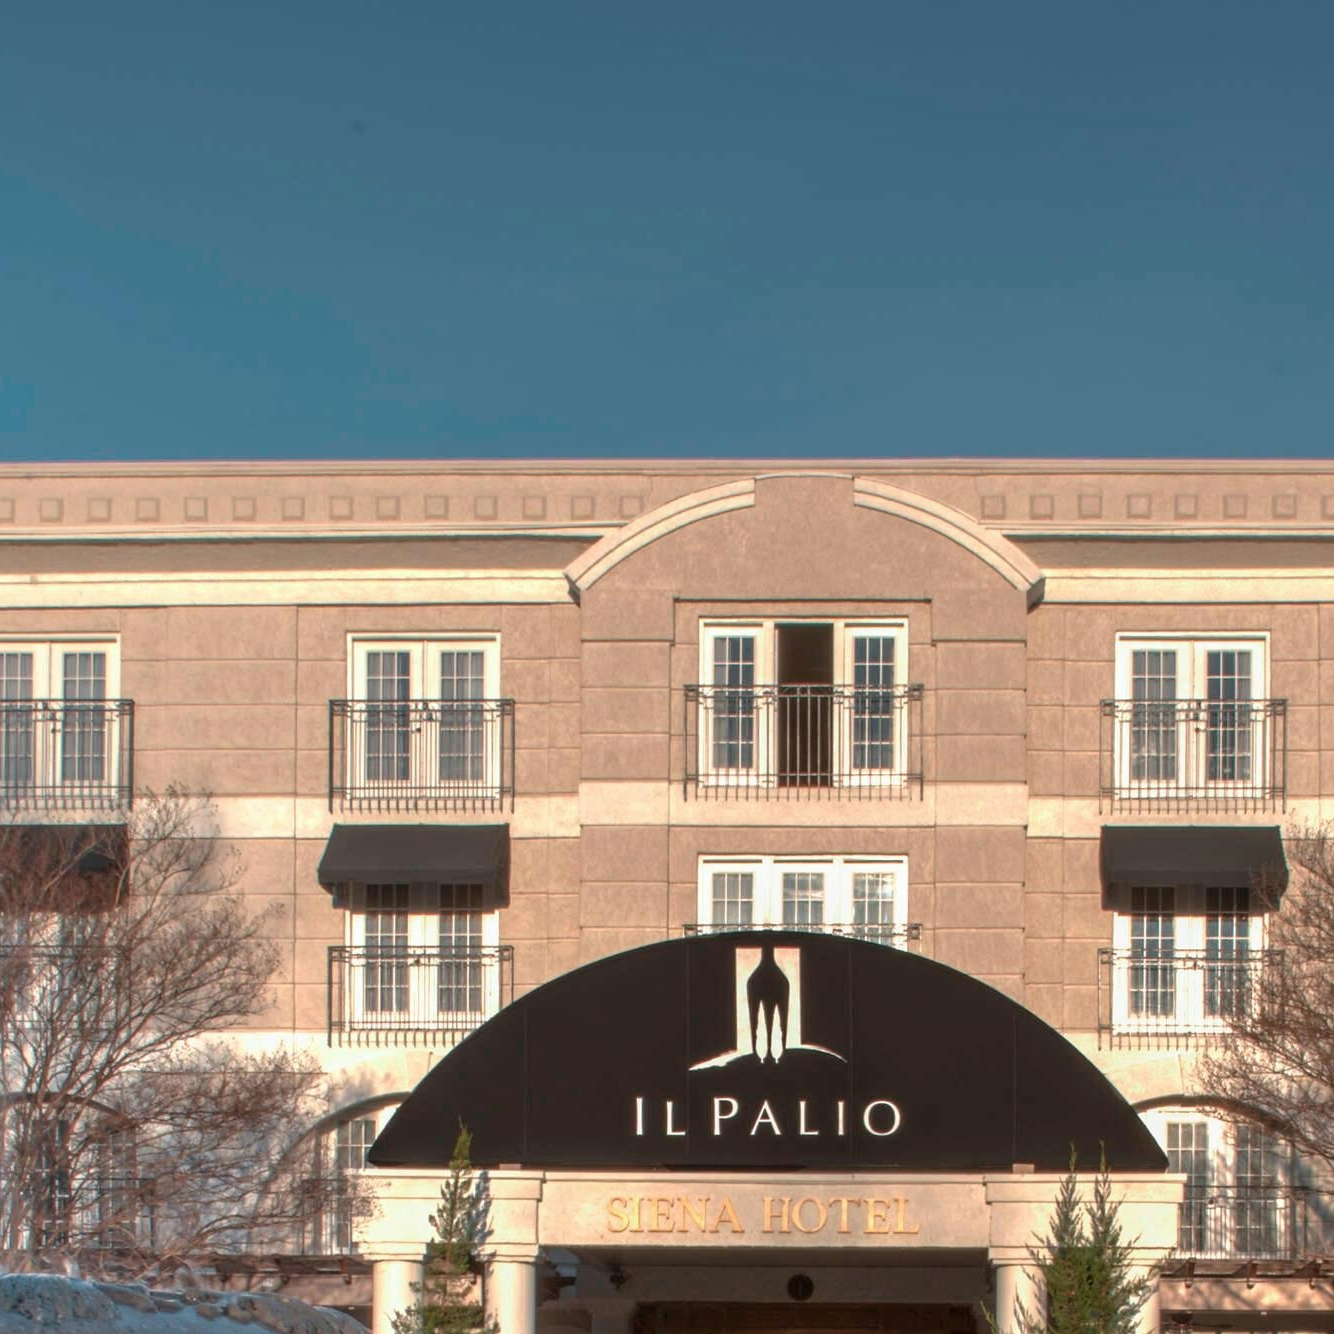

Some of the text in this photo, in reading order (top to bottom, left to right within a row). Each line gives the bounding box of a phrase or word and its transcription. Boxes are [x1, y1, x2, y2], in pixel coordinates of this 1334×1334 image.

[635, 1096, 901, 1136] IL PALIO
[605, 1195, 920, 1235] SIENA HOTEL
